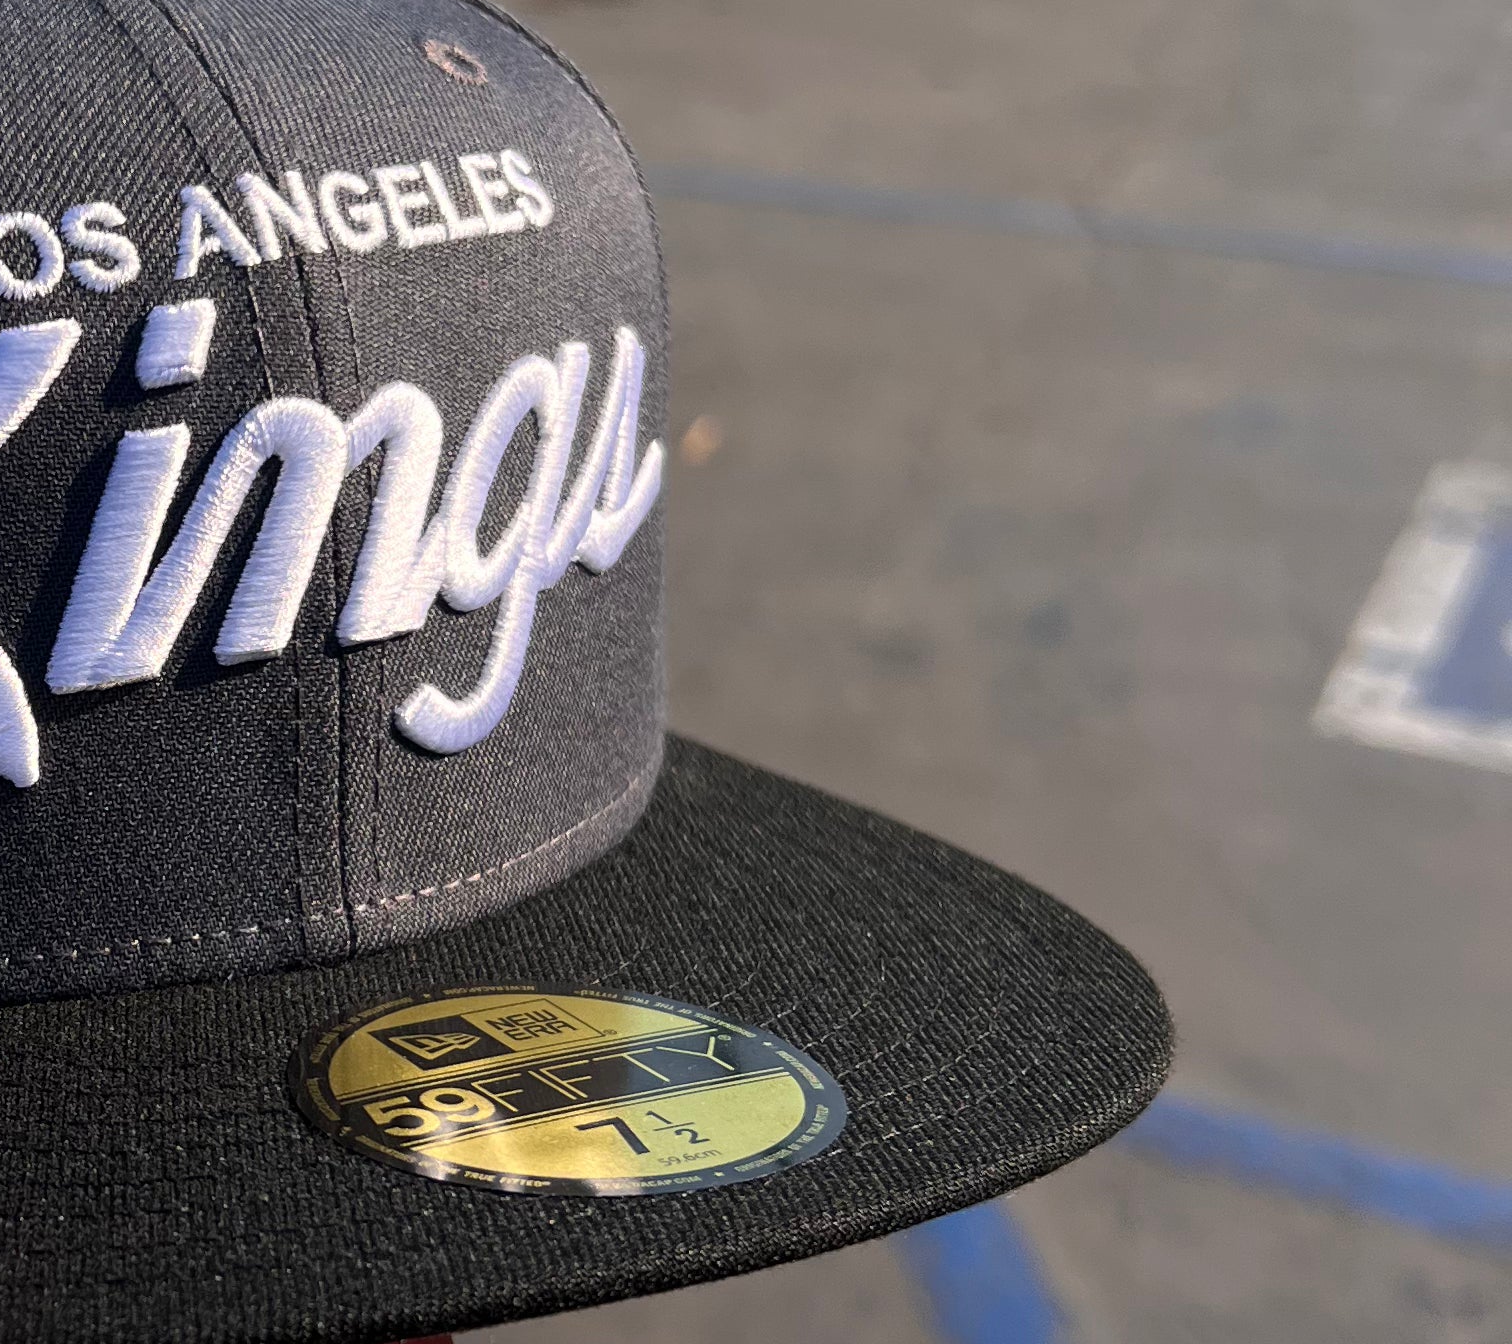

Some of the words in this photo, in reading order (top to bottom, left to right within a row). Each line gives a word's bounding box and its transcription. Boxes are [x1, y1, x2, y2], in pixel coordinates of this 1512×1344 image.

[174, 149, 556, 279] ANGELES
[485, 1009, 558, 1031] NEW
[503, 1021, 577, 1042] ERA
[574, 1116, 650, 1154] 7
[657, 1148, 722, 1167] 59.6cm
